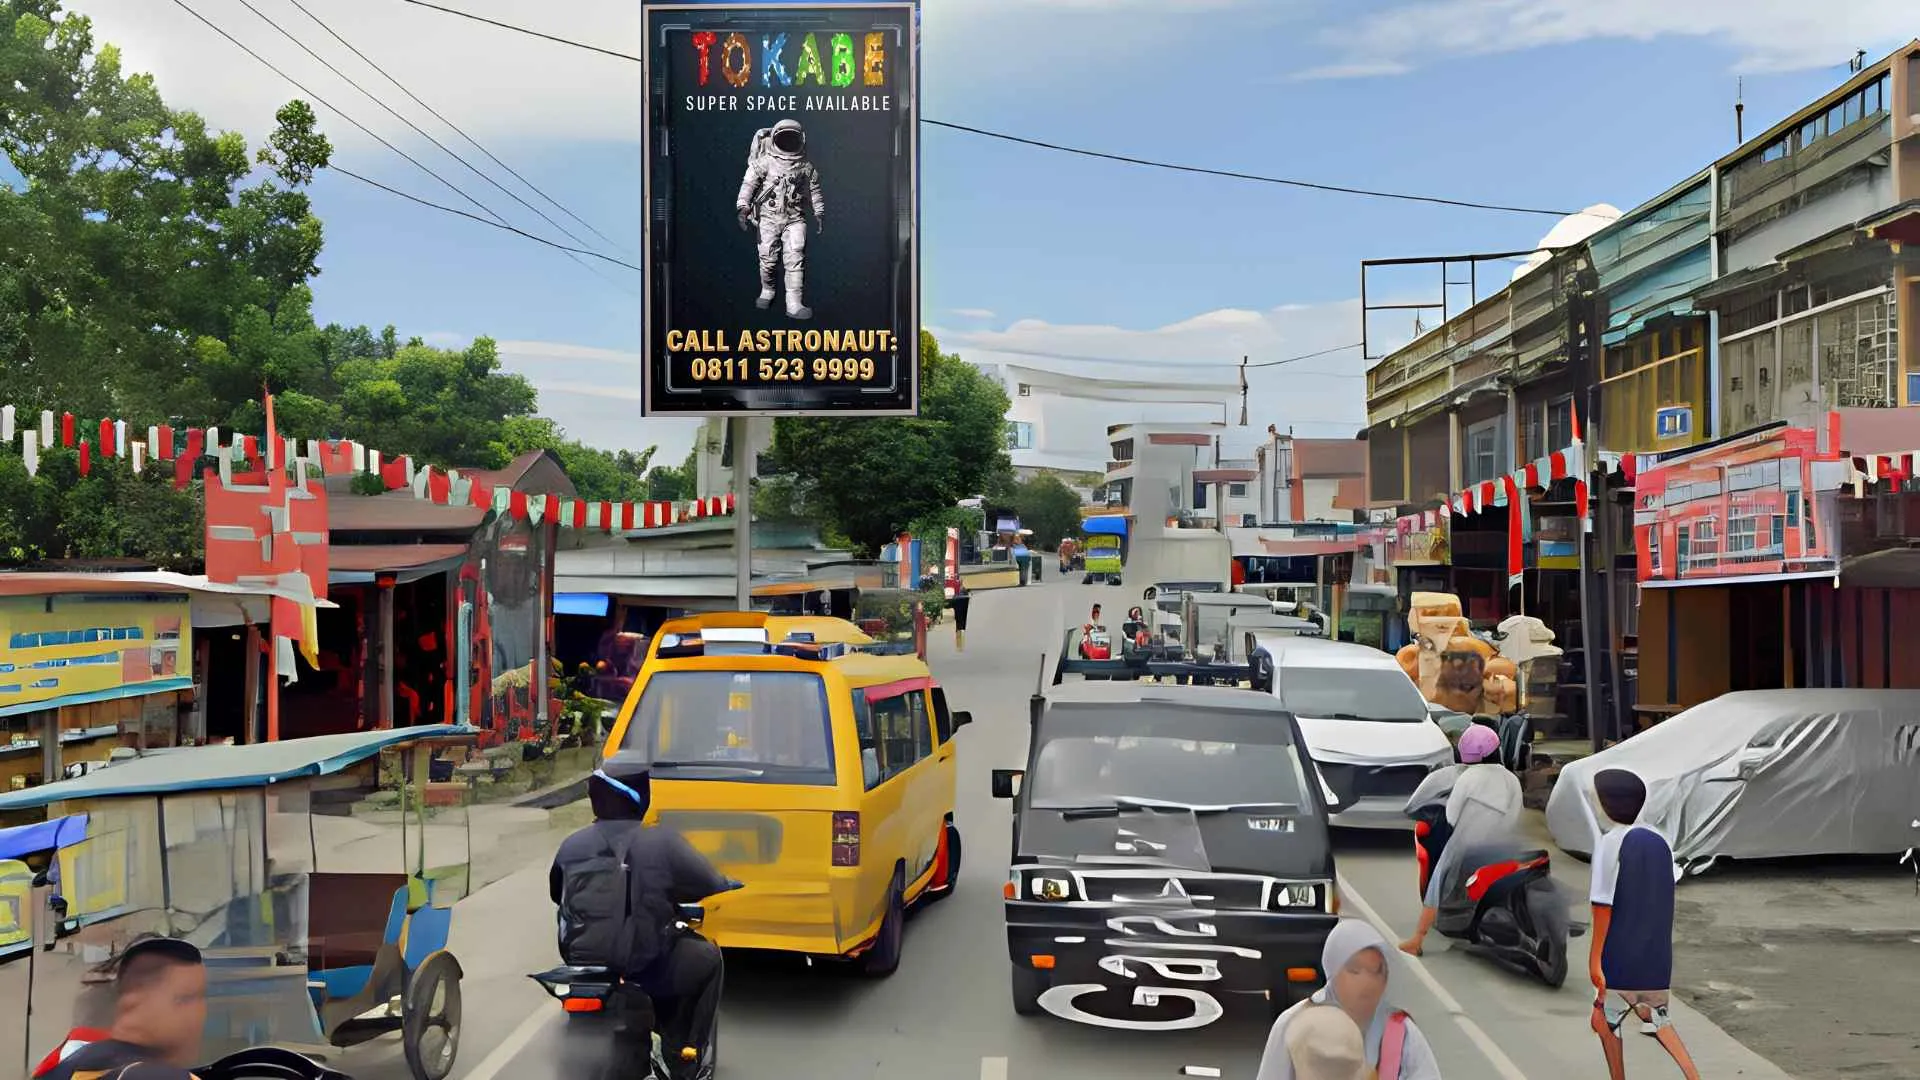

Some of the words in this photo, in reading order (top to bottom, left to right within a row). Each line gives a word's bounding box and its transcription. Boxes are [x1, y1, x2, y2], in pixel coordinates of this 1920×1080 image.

[692, 32, 885, 88] TOKABE
[686, 96, 737, 110] SUPER
[746, 96, 797, 110] SPACE
[805, 96, 890, 110] AVAILABLE
[667, 330, 729, 352] CALL
[738, 330, 897, 352] ASTRONAUT:
[691, 358, 748, 380] 0811
[759, 358, 804, 380] 523
[813, 358, 875, 380] 9999
